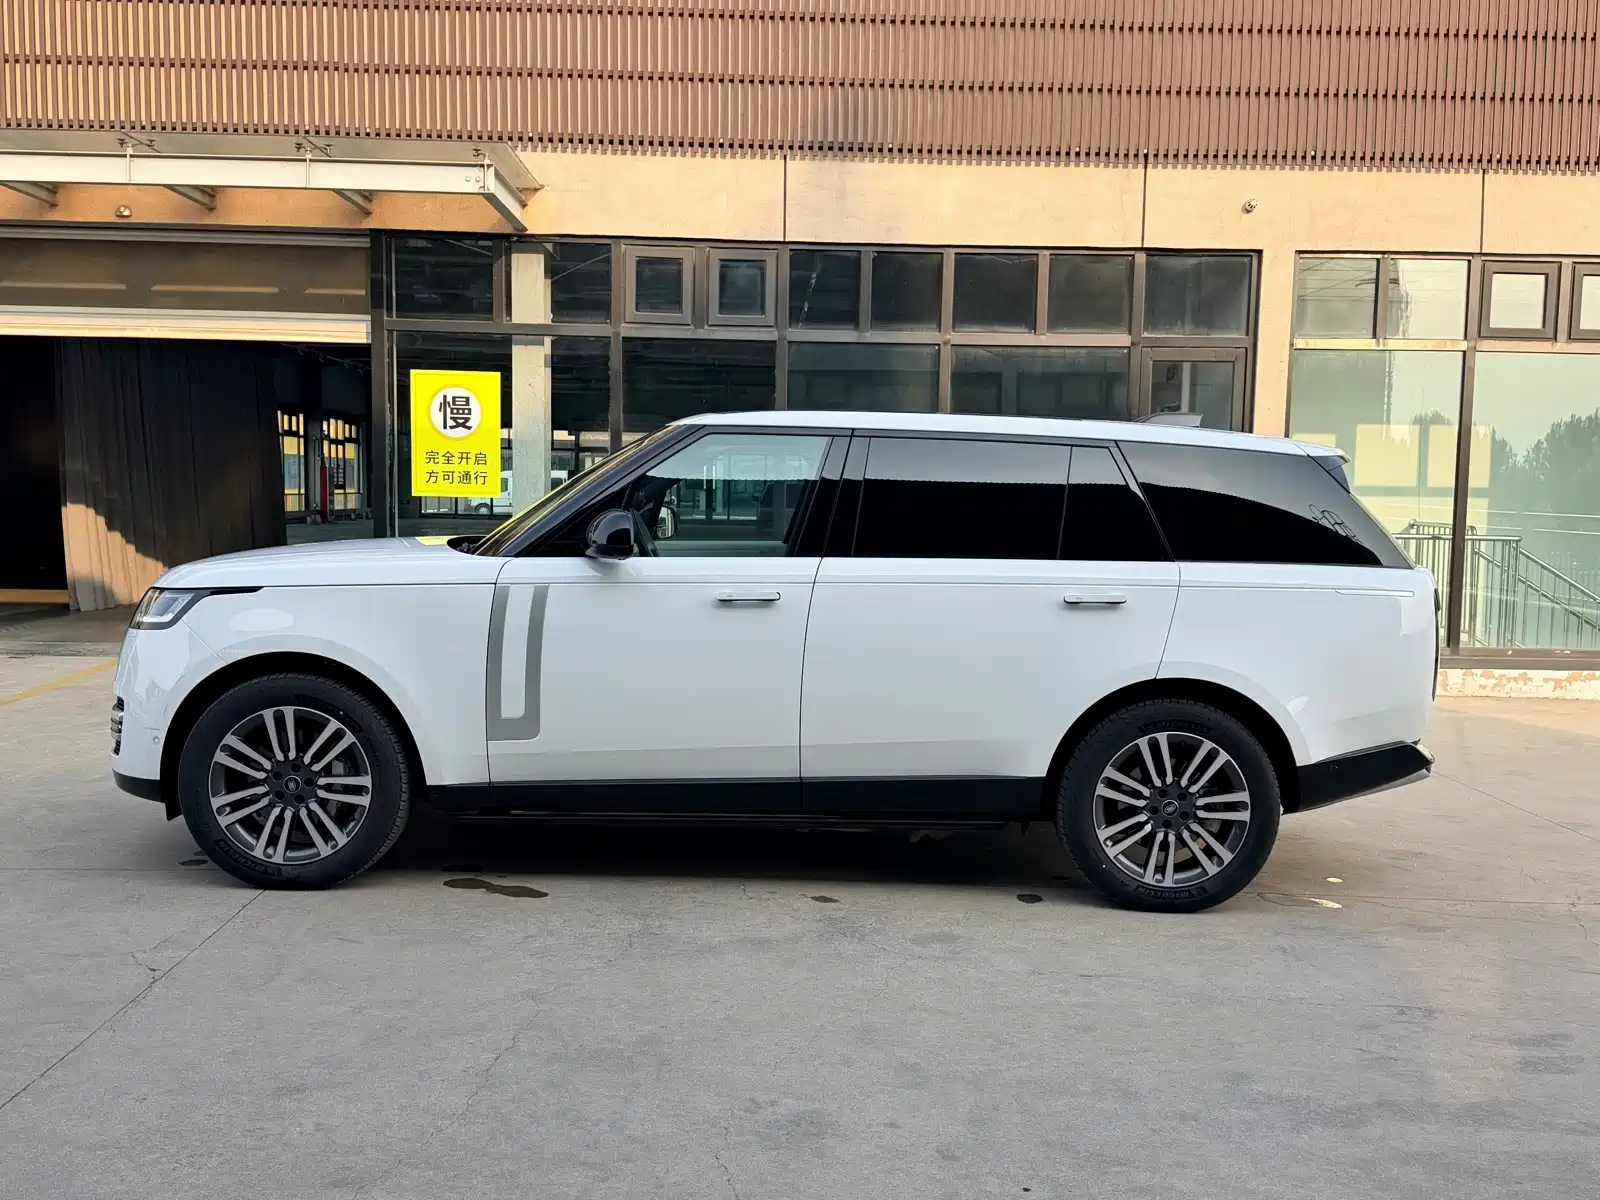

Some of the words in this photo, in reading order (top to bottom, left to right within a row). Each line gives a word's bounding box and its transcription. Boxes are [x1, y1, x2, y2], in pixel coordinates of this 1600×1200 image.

[439, 394, 473, 430] 慢
[425, 450, 488, 466] 完全开启
[425, 470, 488, 485] 方可通行
